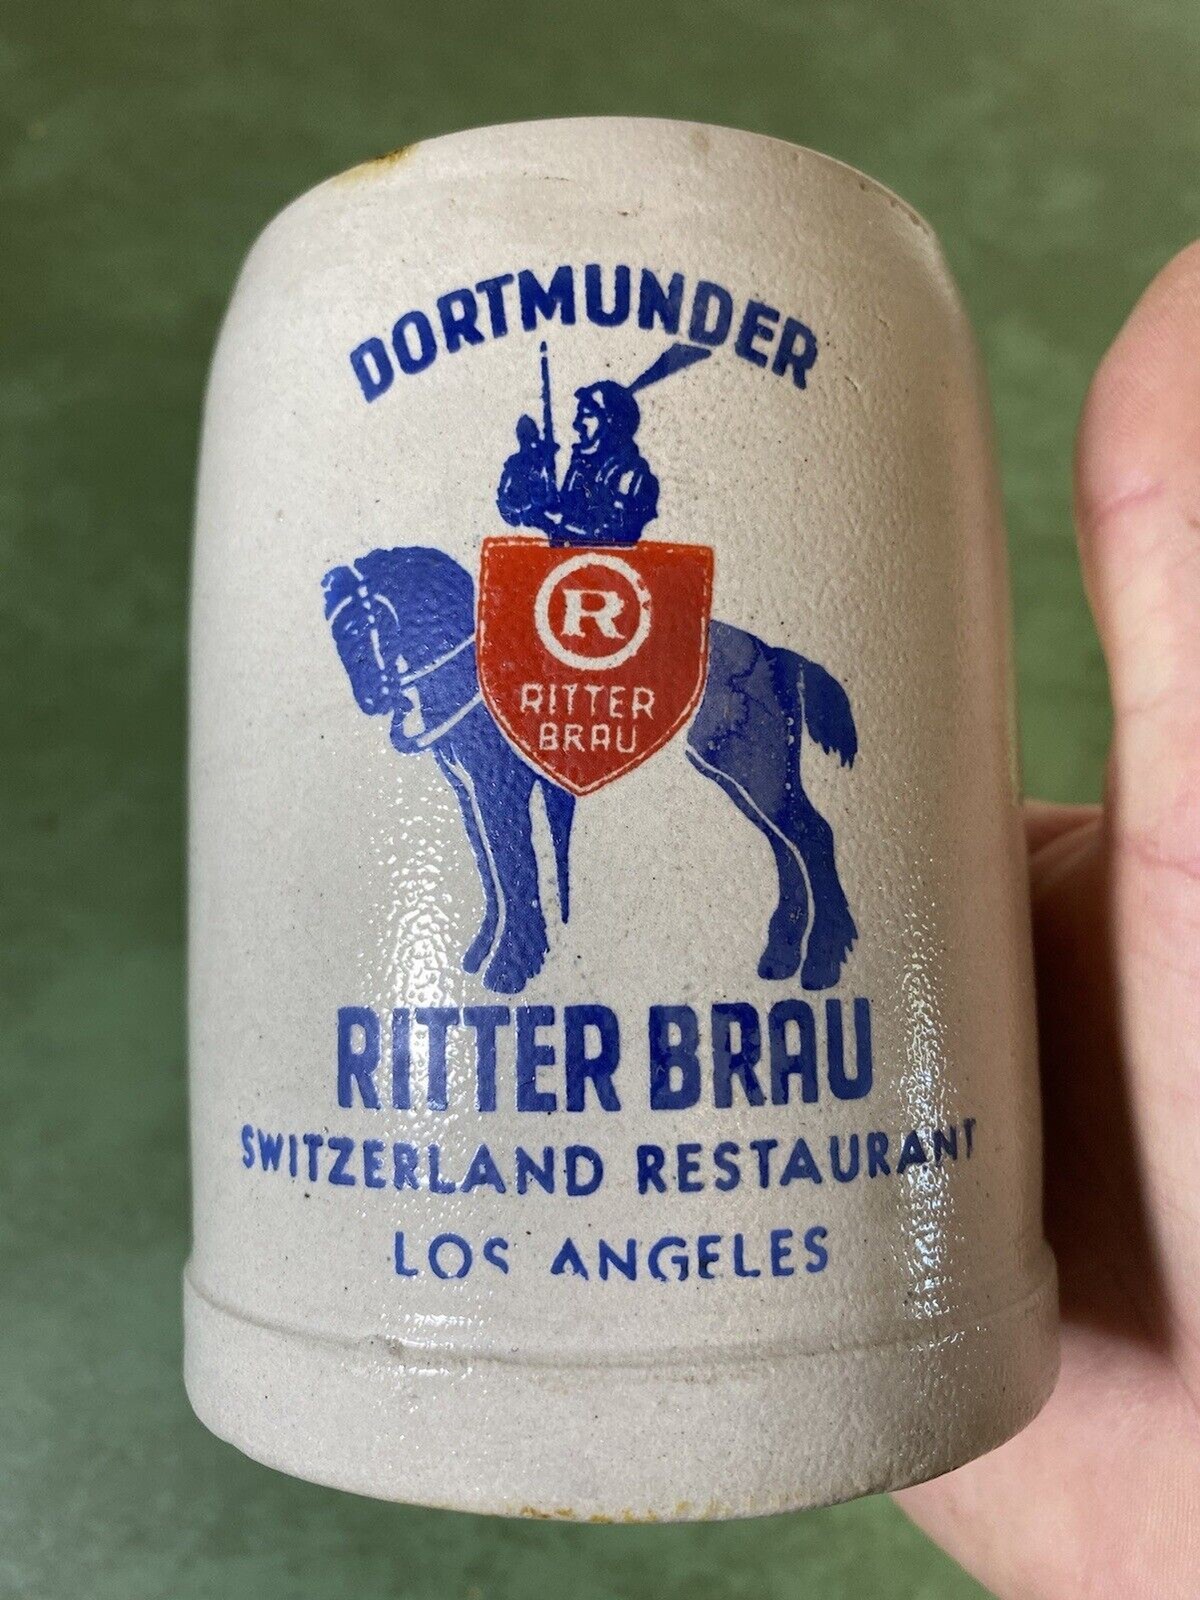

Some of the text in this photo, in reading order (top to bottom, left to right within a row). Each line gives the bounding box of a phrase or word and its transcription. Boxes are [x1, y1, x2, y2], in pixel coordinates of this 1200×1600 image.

[348, 263, 817, 403] DORTMUNDER
[560, 588, 626, 640] R
[519, 682, 656, 720] RITTER
[539, 722, 637, 753] BRAU
[336, 998, 873, 1113] RITTER BRAU
[240, 1116, 978, 1198] SWITZERLAND RESTAURANT
[393, 1226, 829, 1283] LOS ANGELES
